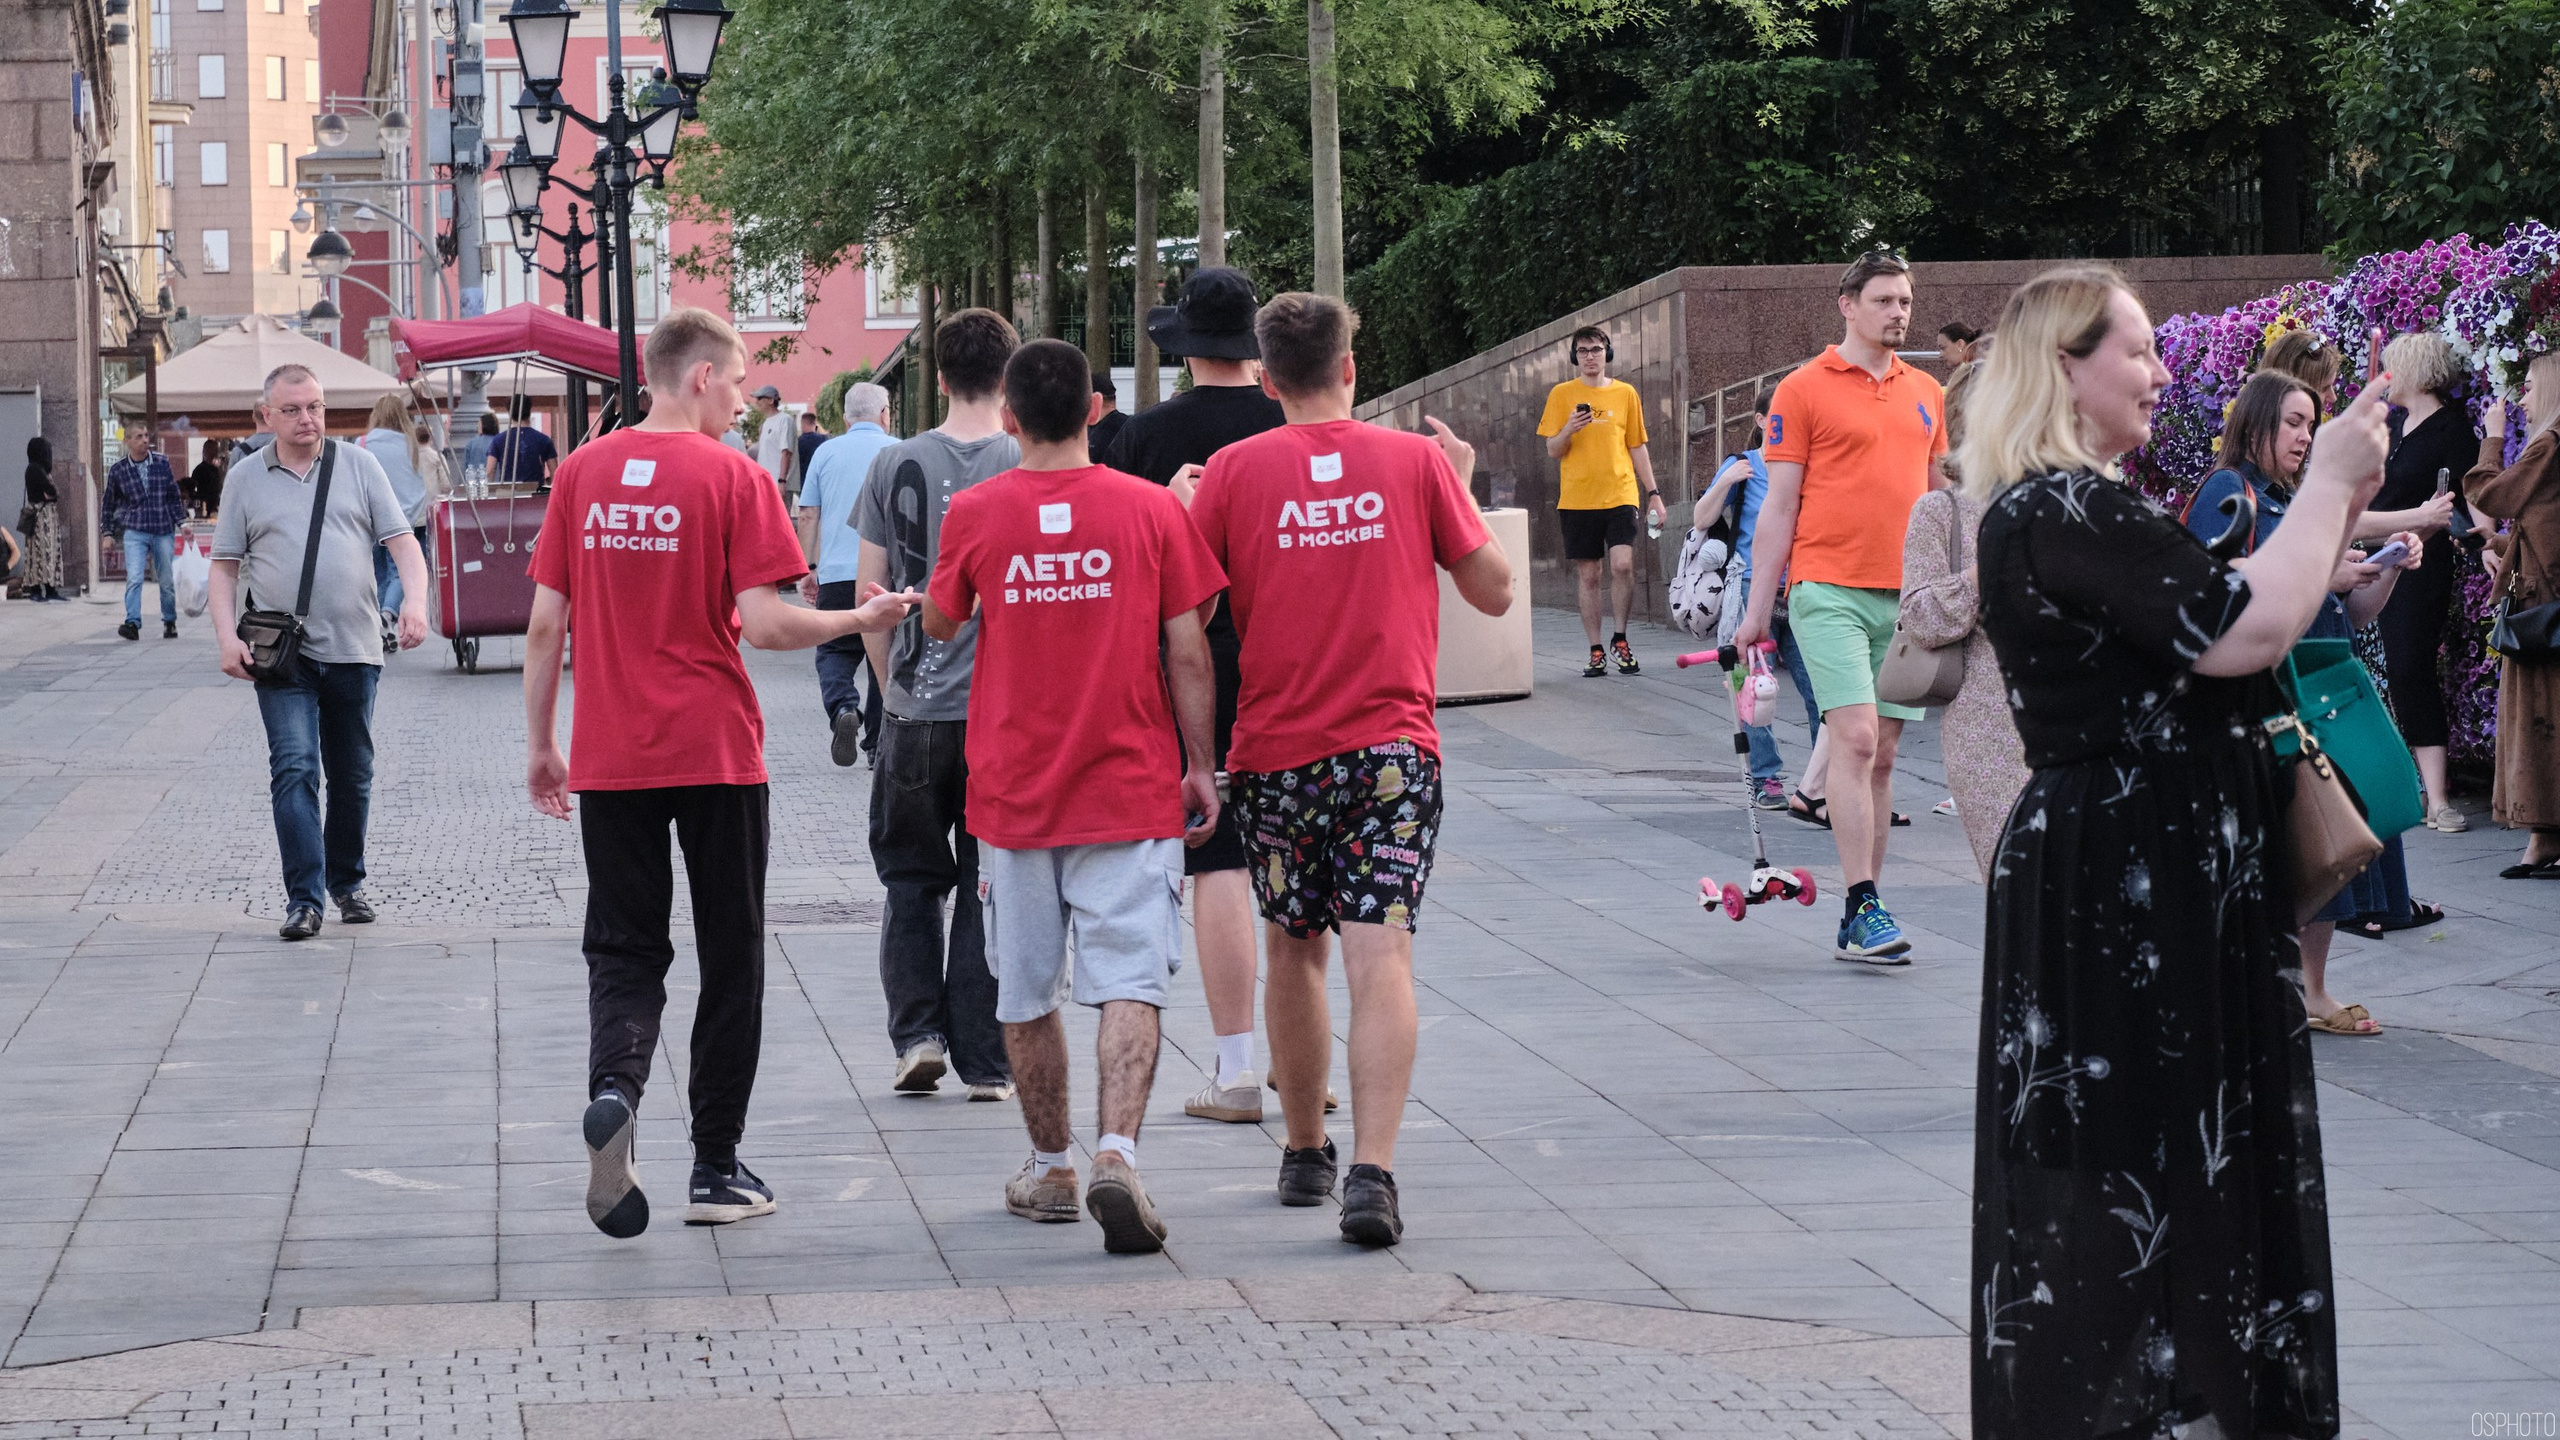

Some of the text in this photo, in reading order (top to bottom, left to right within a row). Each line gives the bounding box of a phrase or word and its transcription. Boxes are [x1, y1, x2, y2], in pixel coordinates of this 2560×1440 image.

[1769, 414, 1783, 445] 3
[584, 502, 681, 533] ЛЕТО
[1277, 491, 1385, 529] ЛЕТО
[584, 535, 595, 550] В
[1278, 524, 1385, 549] В МОСКВЕ
[1005, 548, 1112, 583] ЛЕТО
[1005, 582, 1112, 604] В МОСКВЕ
